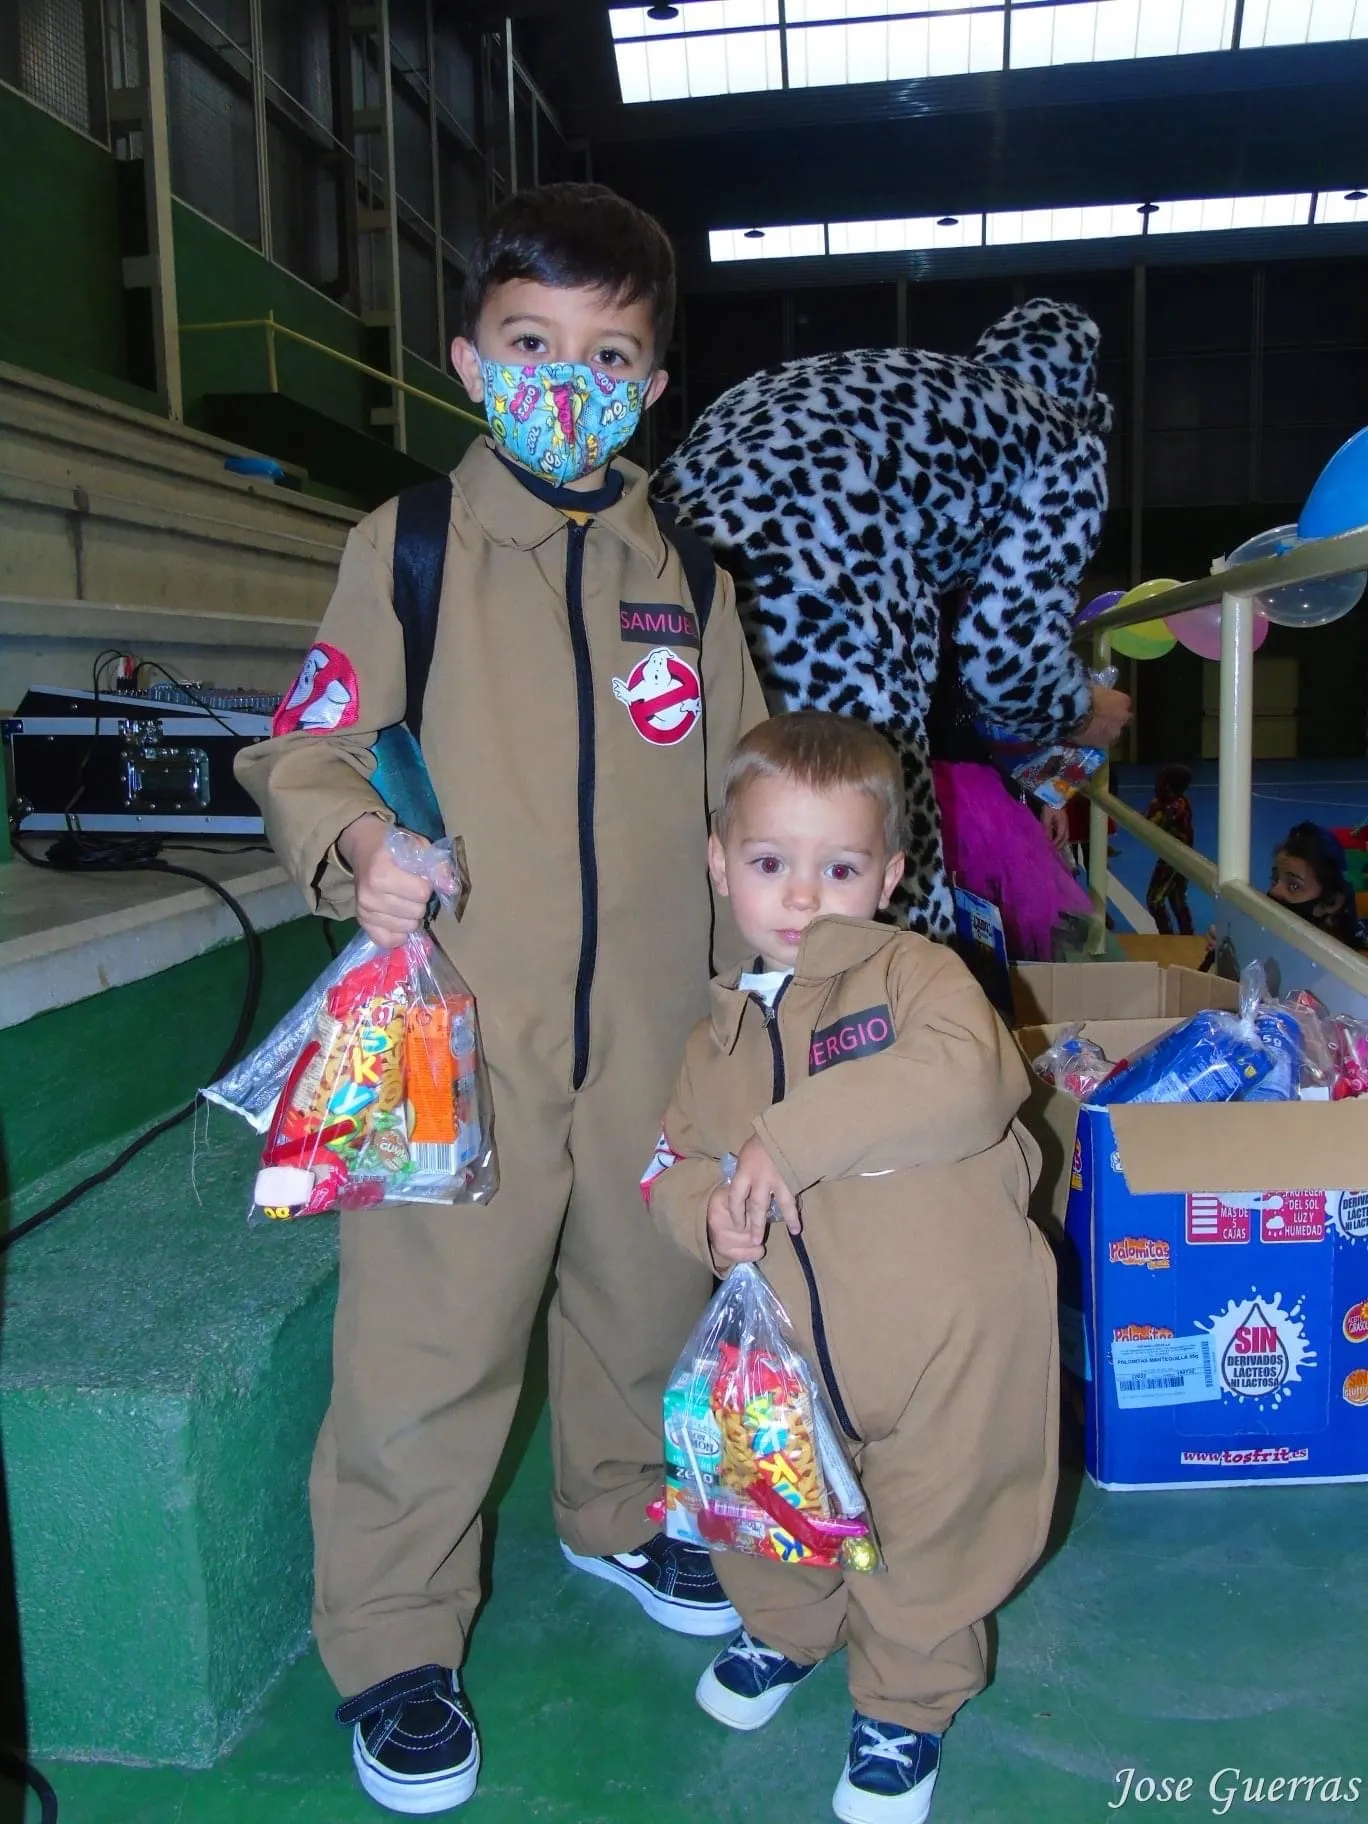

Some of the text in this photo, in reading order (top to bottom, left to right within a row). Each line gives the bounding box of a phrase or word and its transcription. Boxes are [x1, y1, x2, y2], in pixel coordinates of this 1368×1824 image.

[620, 611, 697, 636] SAMUE
[809, 1018, 888, 1066] ERGIO
[1289, 1199, 1320, 1210] DEL SOL
[1238, 1207, 1249, 1218] DE
[1293, 1212, 1315, 1223] LUZ Y
[1222, 1227, 1246, 1240] CAJAS
[1284, 1225, 1323, 1236] HUMEDAD
[1109, 1239, 1170, 1262] Palomitas
[1234, 1326, 1277, 1354] SIN
[1227, 1354, 1283, 1367] DERIVADOS
[1230, 1377, 1279, 1388] NI LACTOSA
[1182, 1447, 1307, 1465] www.tosfrit.es
[676, 1466, 714, 1485] zeo
